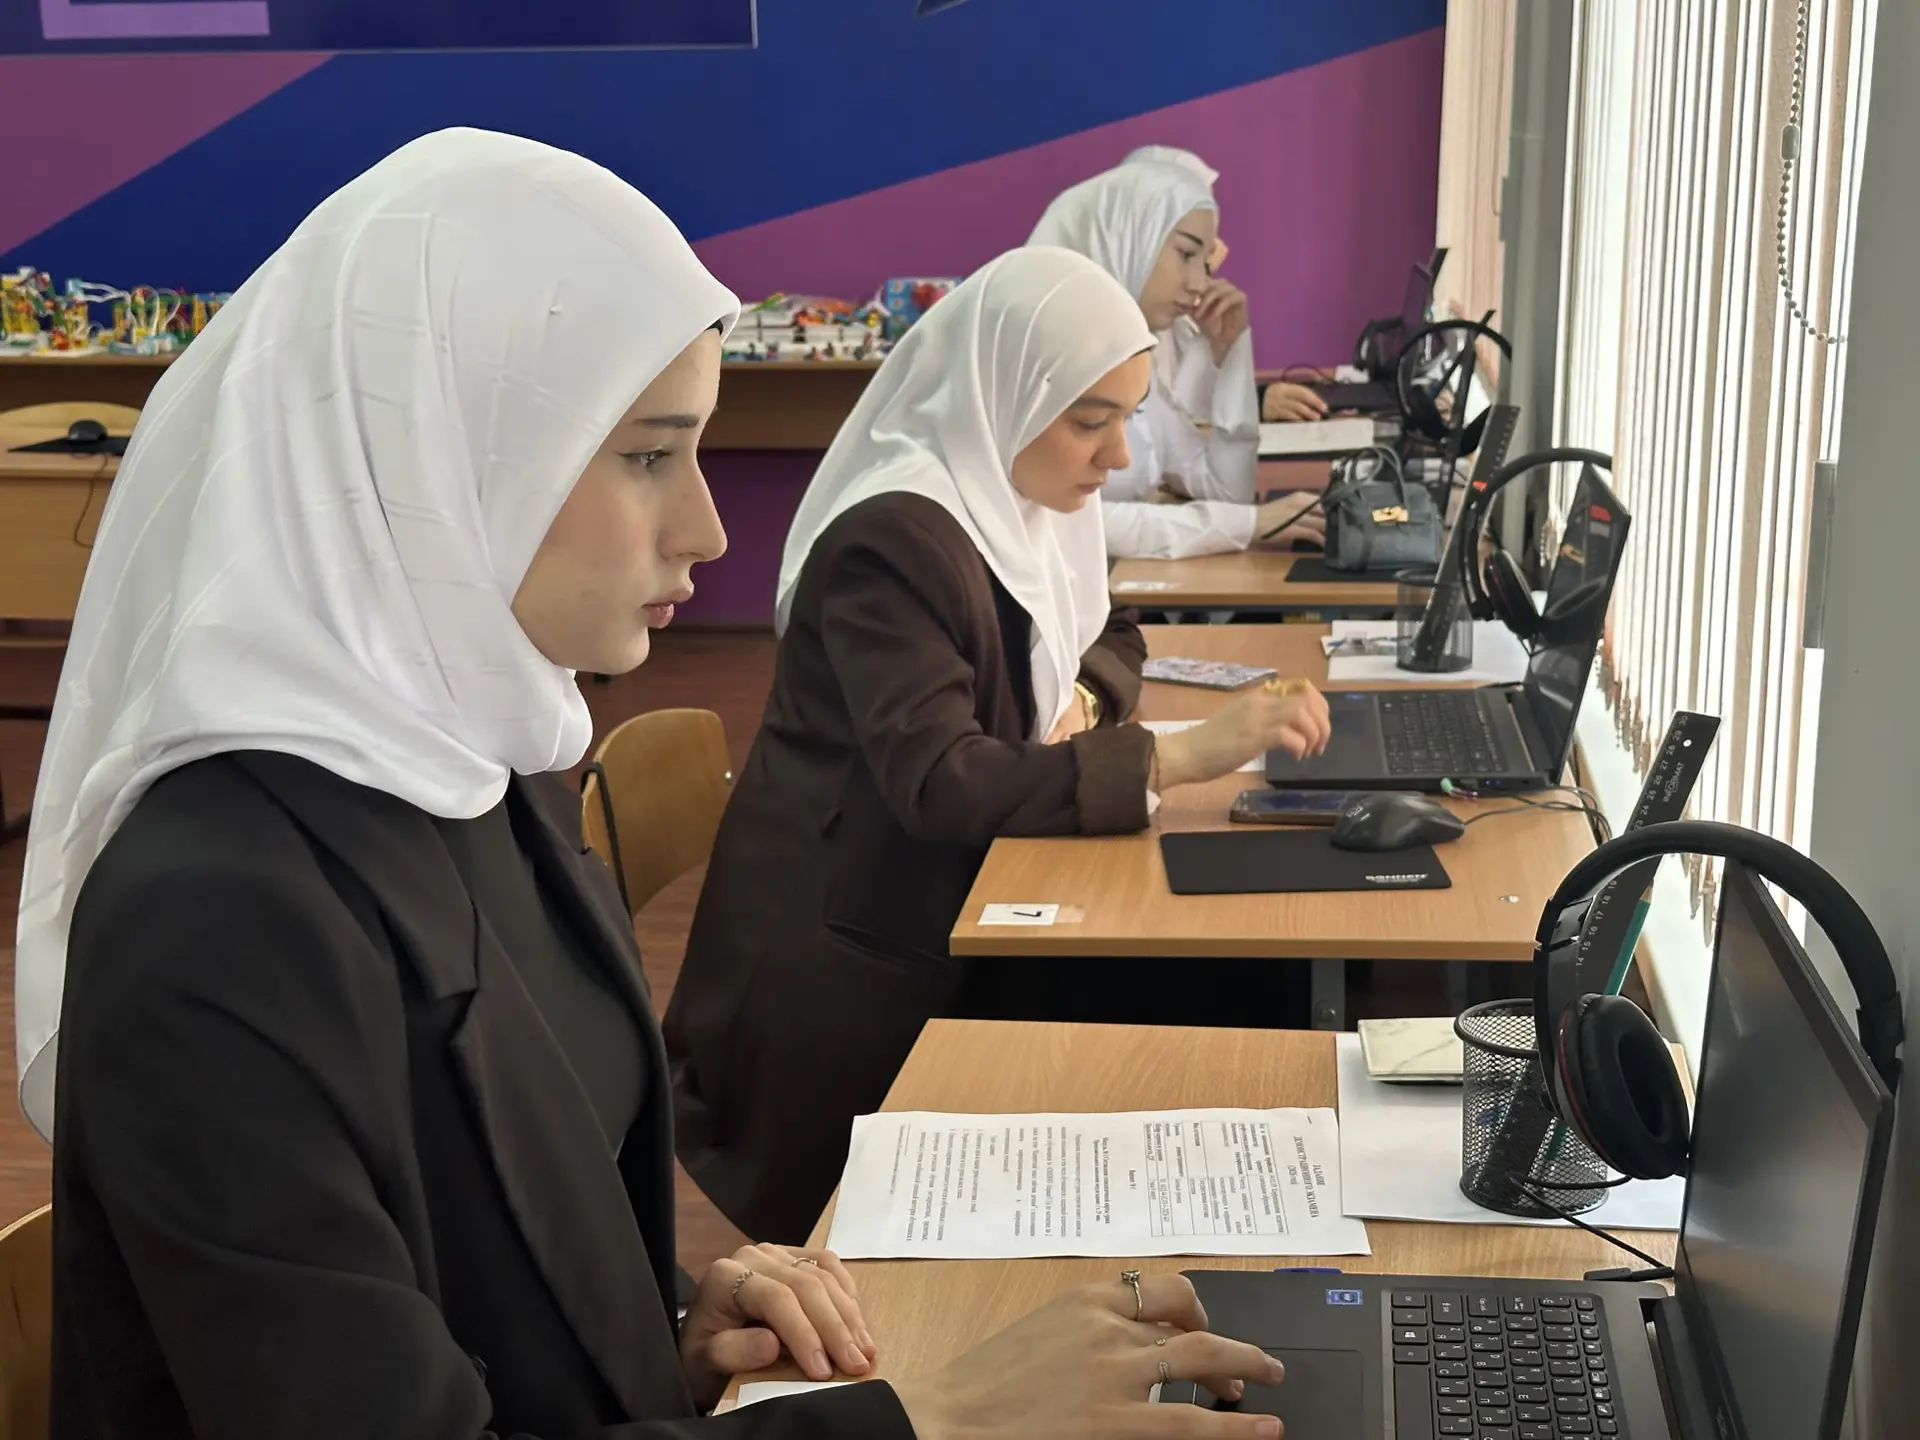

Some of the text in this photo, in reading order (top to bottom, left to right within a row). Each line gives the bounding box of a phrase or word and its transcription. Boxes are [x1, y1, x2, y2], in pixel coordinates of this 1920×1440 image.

[1640, 805, 1649, 815] 24
[1647, 789, 1656, 800] 25
[1654, 775, 1663, 785] 26
[1659, 760, 1668, 770] 27
[1666, 745, 1676, 755] 28
[1672, 730, 1682, 741] 29
[1679, 715, 1688, 725] 30
[1663, 762, 1684, 802] INFORMAT
[1576, 880, 1617, 966] 14 15 16 17 18 19
